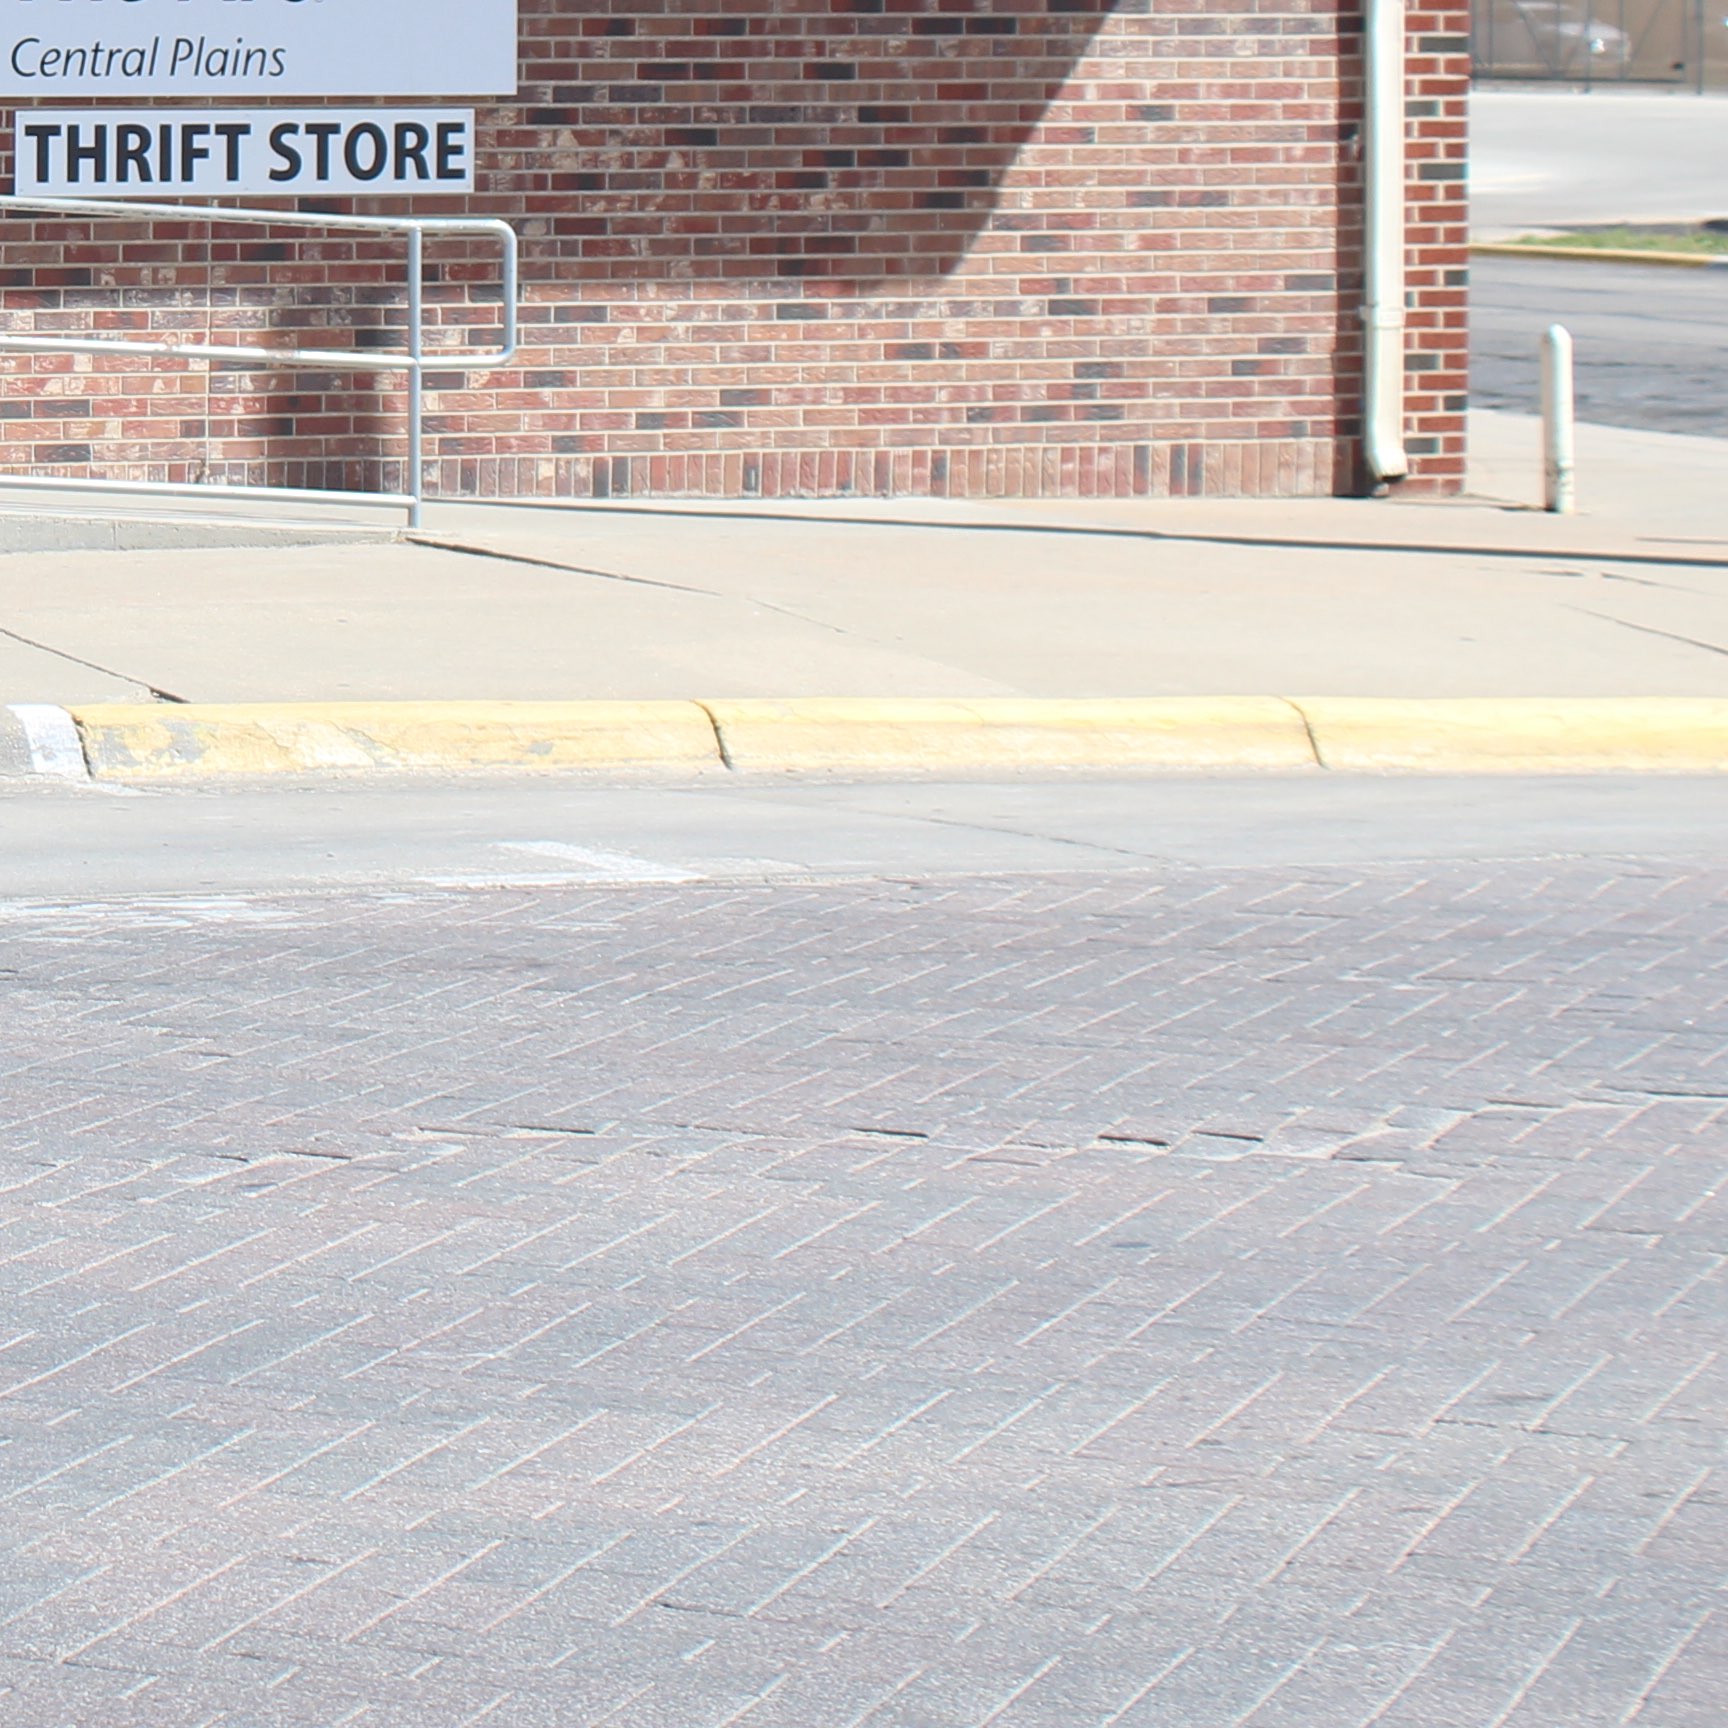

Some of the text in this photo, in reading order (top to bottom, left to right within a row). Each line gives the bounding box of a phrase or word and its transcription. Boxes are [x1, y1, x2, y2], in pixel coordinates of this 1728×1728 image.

[11, 36, 286, 77] Central Plains
[24, 121, 466, 184] THRIFT STORE
